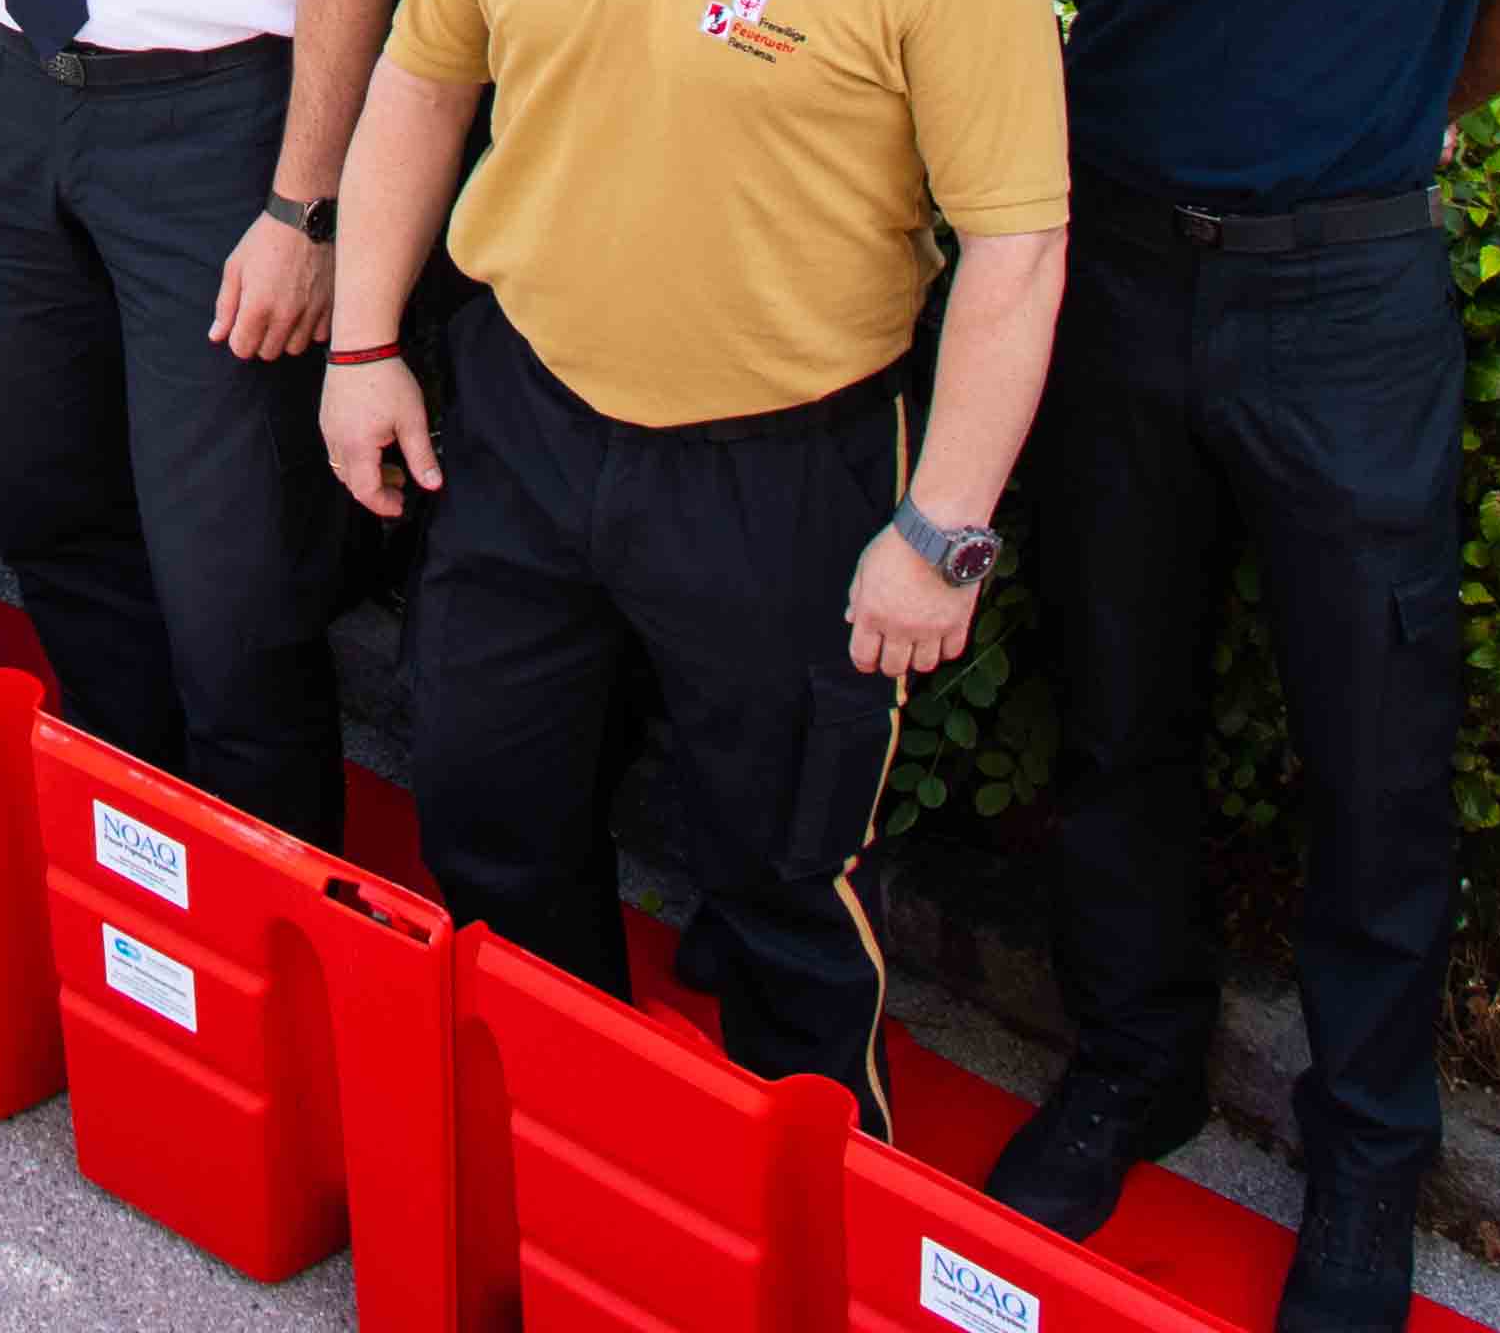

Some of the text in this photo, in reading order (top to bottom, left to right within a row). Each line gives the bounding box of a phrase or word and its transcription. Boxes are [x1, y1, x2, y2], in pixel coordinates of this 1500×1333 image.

[732, 22, 796, 54] Feuerwehr
[103, 812, 179, 870] NOAQ
[934, 1251, 1028, 1324] NOAQ
